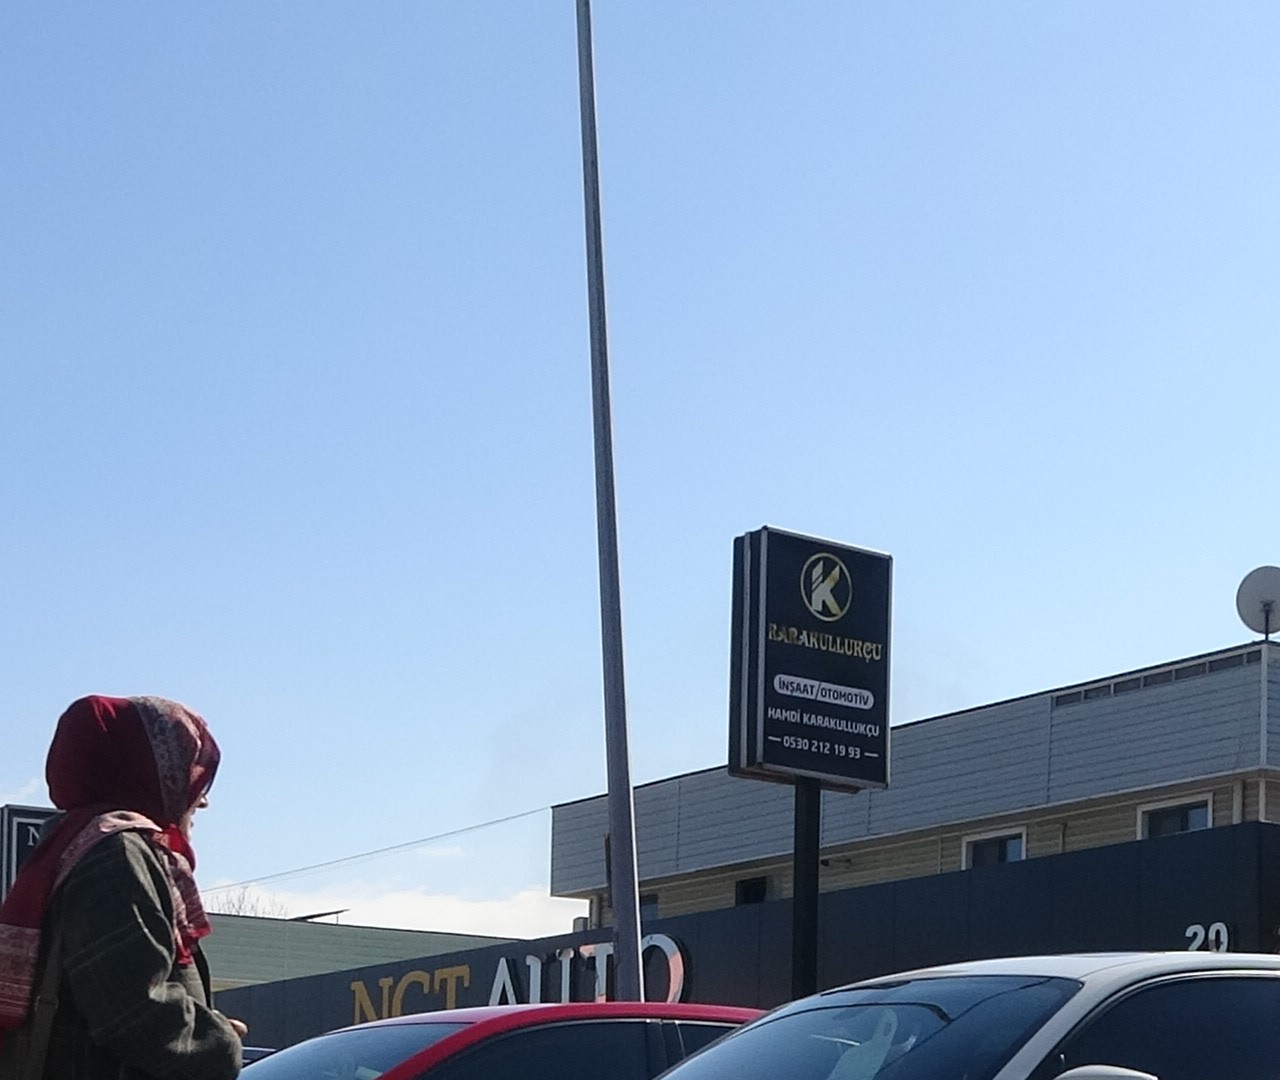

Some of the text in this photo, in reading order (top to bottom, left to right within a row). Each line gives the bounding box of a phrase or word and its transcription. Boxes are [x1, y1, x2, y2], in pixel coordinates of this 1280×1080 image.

[767, 706, 880, 738] HAMDİ KARAKULLUKÇU
[783, 736, 861, 759] 0530 212 19 93
[1184, 921, 1230, 953] 20
[350, 965, 470, 1025] NCT
